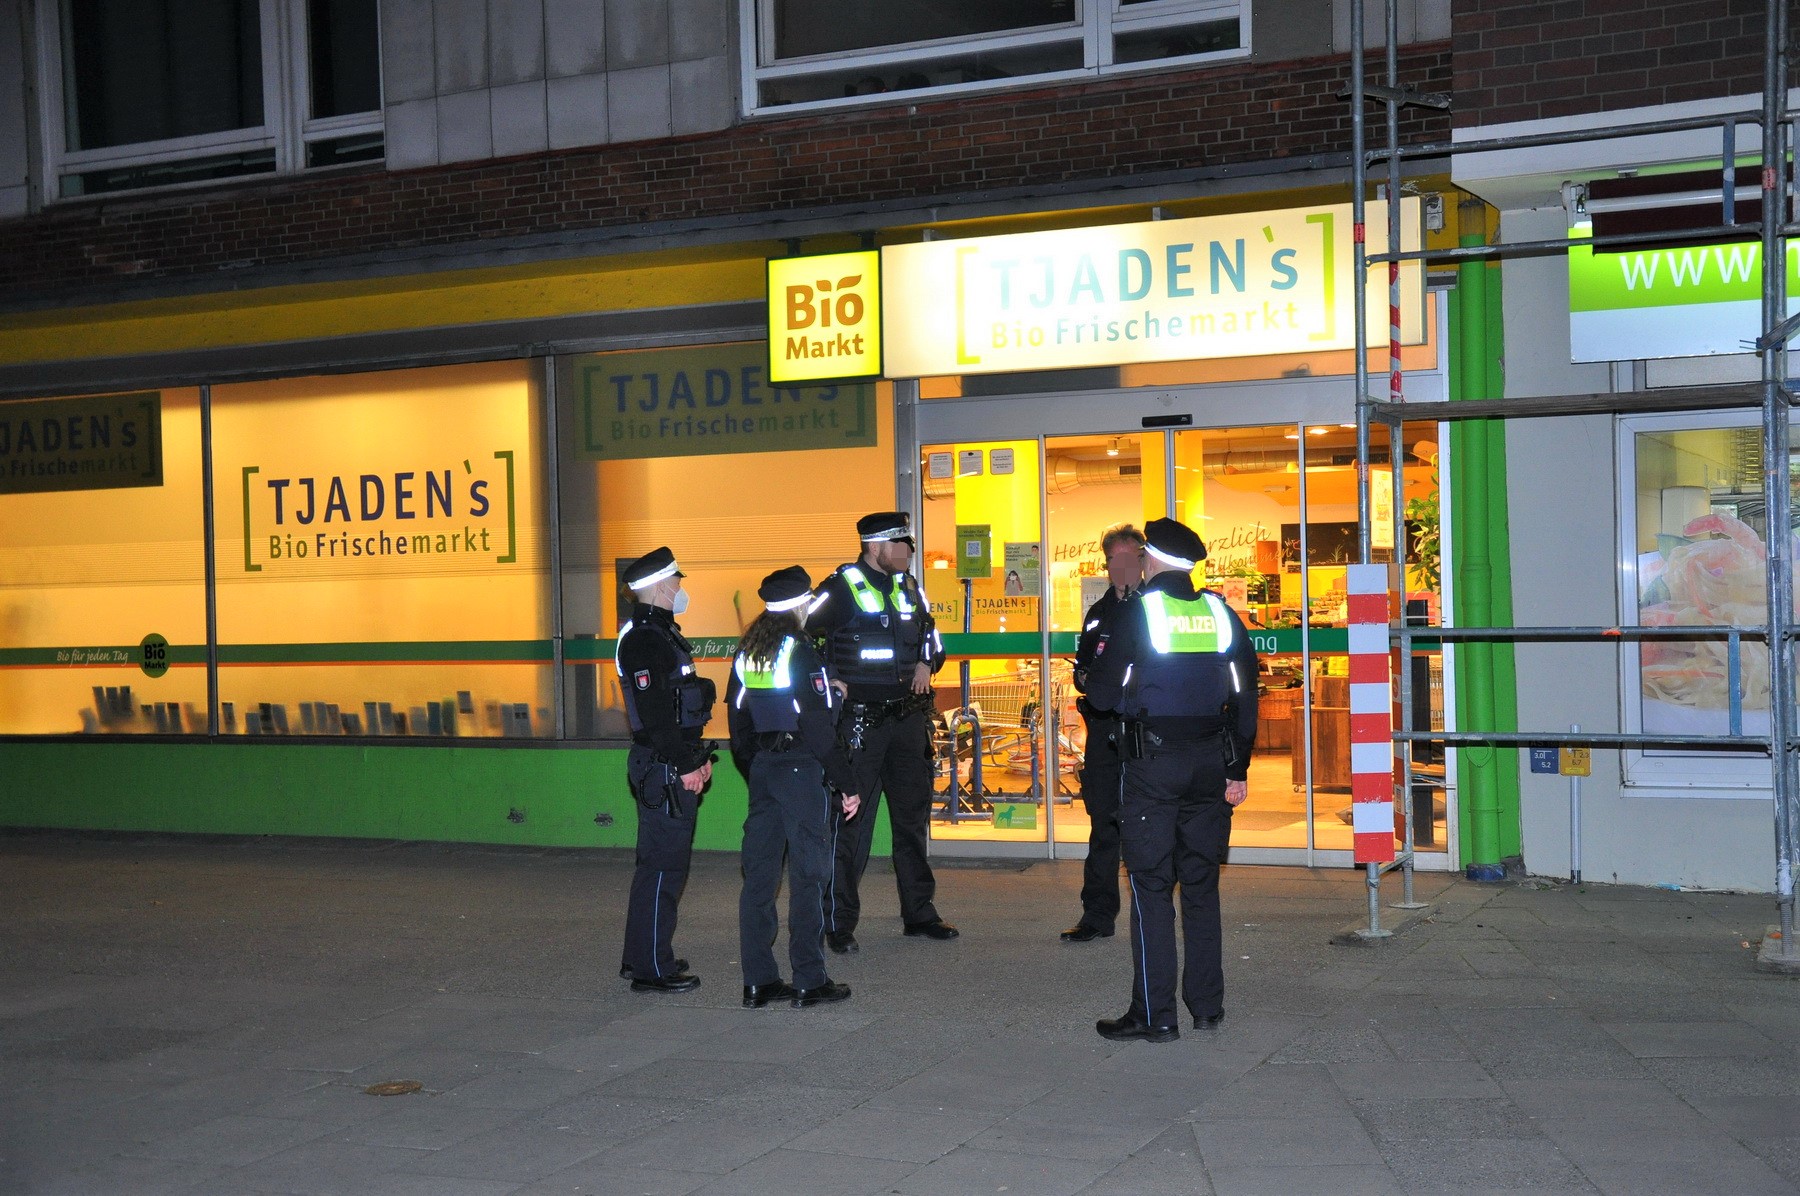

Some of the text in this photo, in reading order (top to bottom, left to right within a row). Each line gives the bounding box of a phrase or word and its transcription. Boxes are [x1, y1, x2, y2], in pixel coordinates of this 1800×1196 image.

[786, 274, 864, 330] Bio
[992, 301, 1299, 348] Bio Frischemarkt
[786, 334, 864, 360] Markt
[612, 409, 839, 441] Bio Frischemarkt
[270, 526, 490, 559] Bio Frischemarkt
[1168, 616, 1216, 633] POLIZEI
[57, 648, 128, 667] Bio für jeden Tag
[144, 643, 166, 660] Bio
[701, 640, 721, 661] für
[144, 661, 165, 670] Markt
